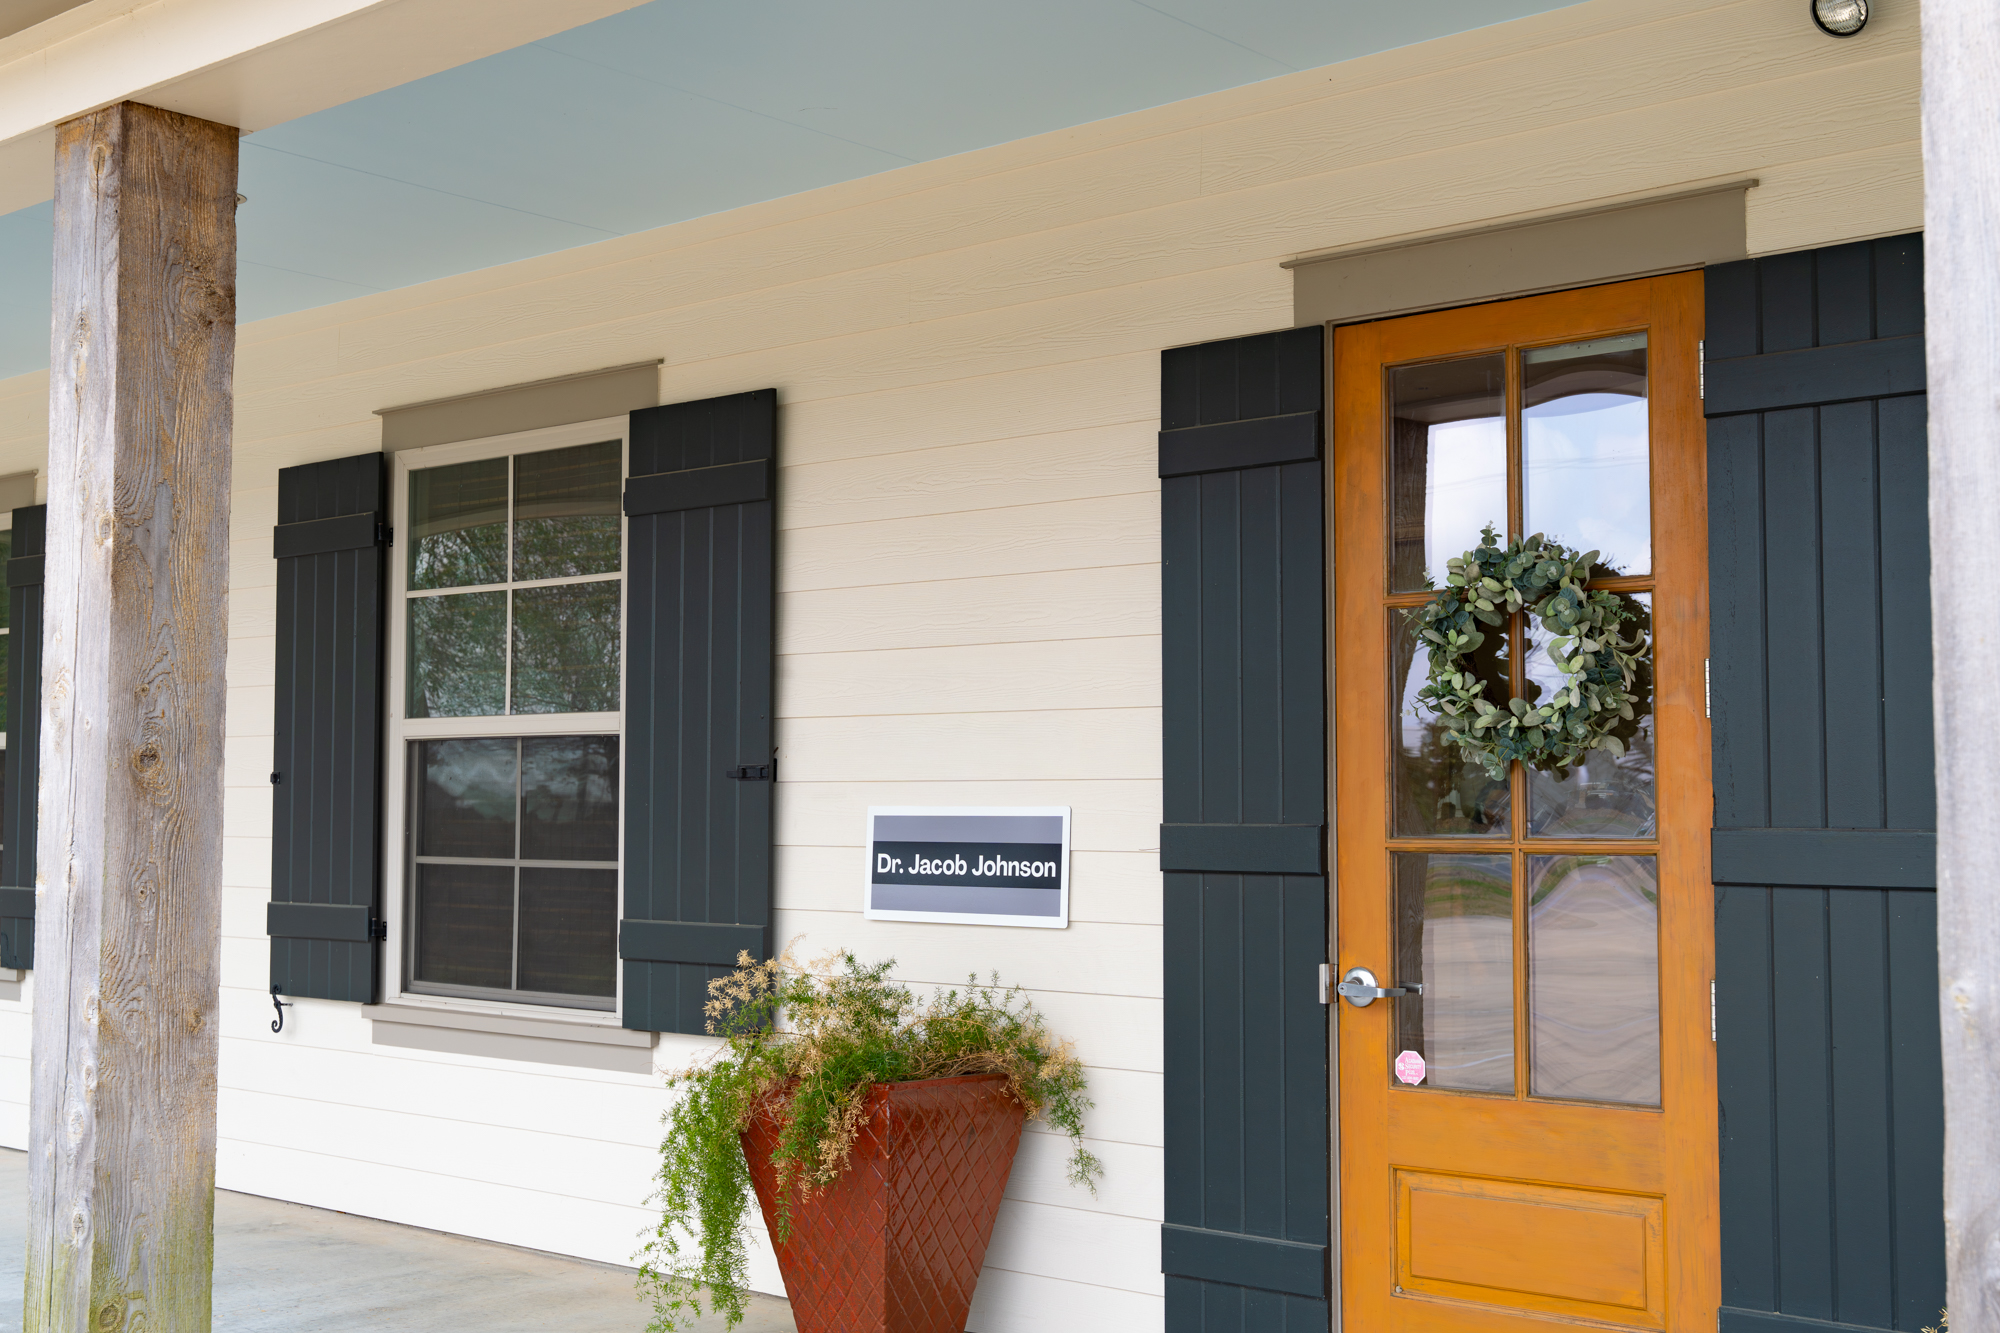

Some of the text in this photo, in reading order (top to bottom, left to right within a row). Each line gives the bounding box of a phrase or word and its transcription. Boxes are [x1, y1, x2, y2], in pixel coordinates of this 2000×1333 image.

[877, 853, 1057, 878] Dr. Jacob Johnson
